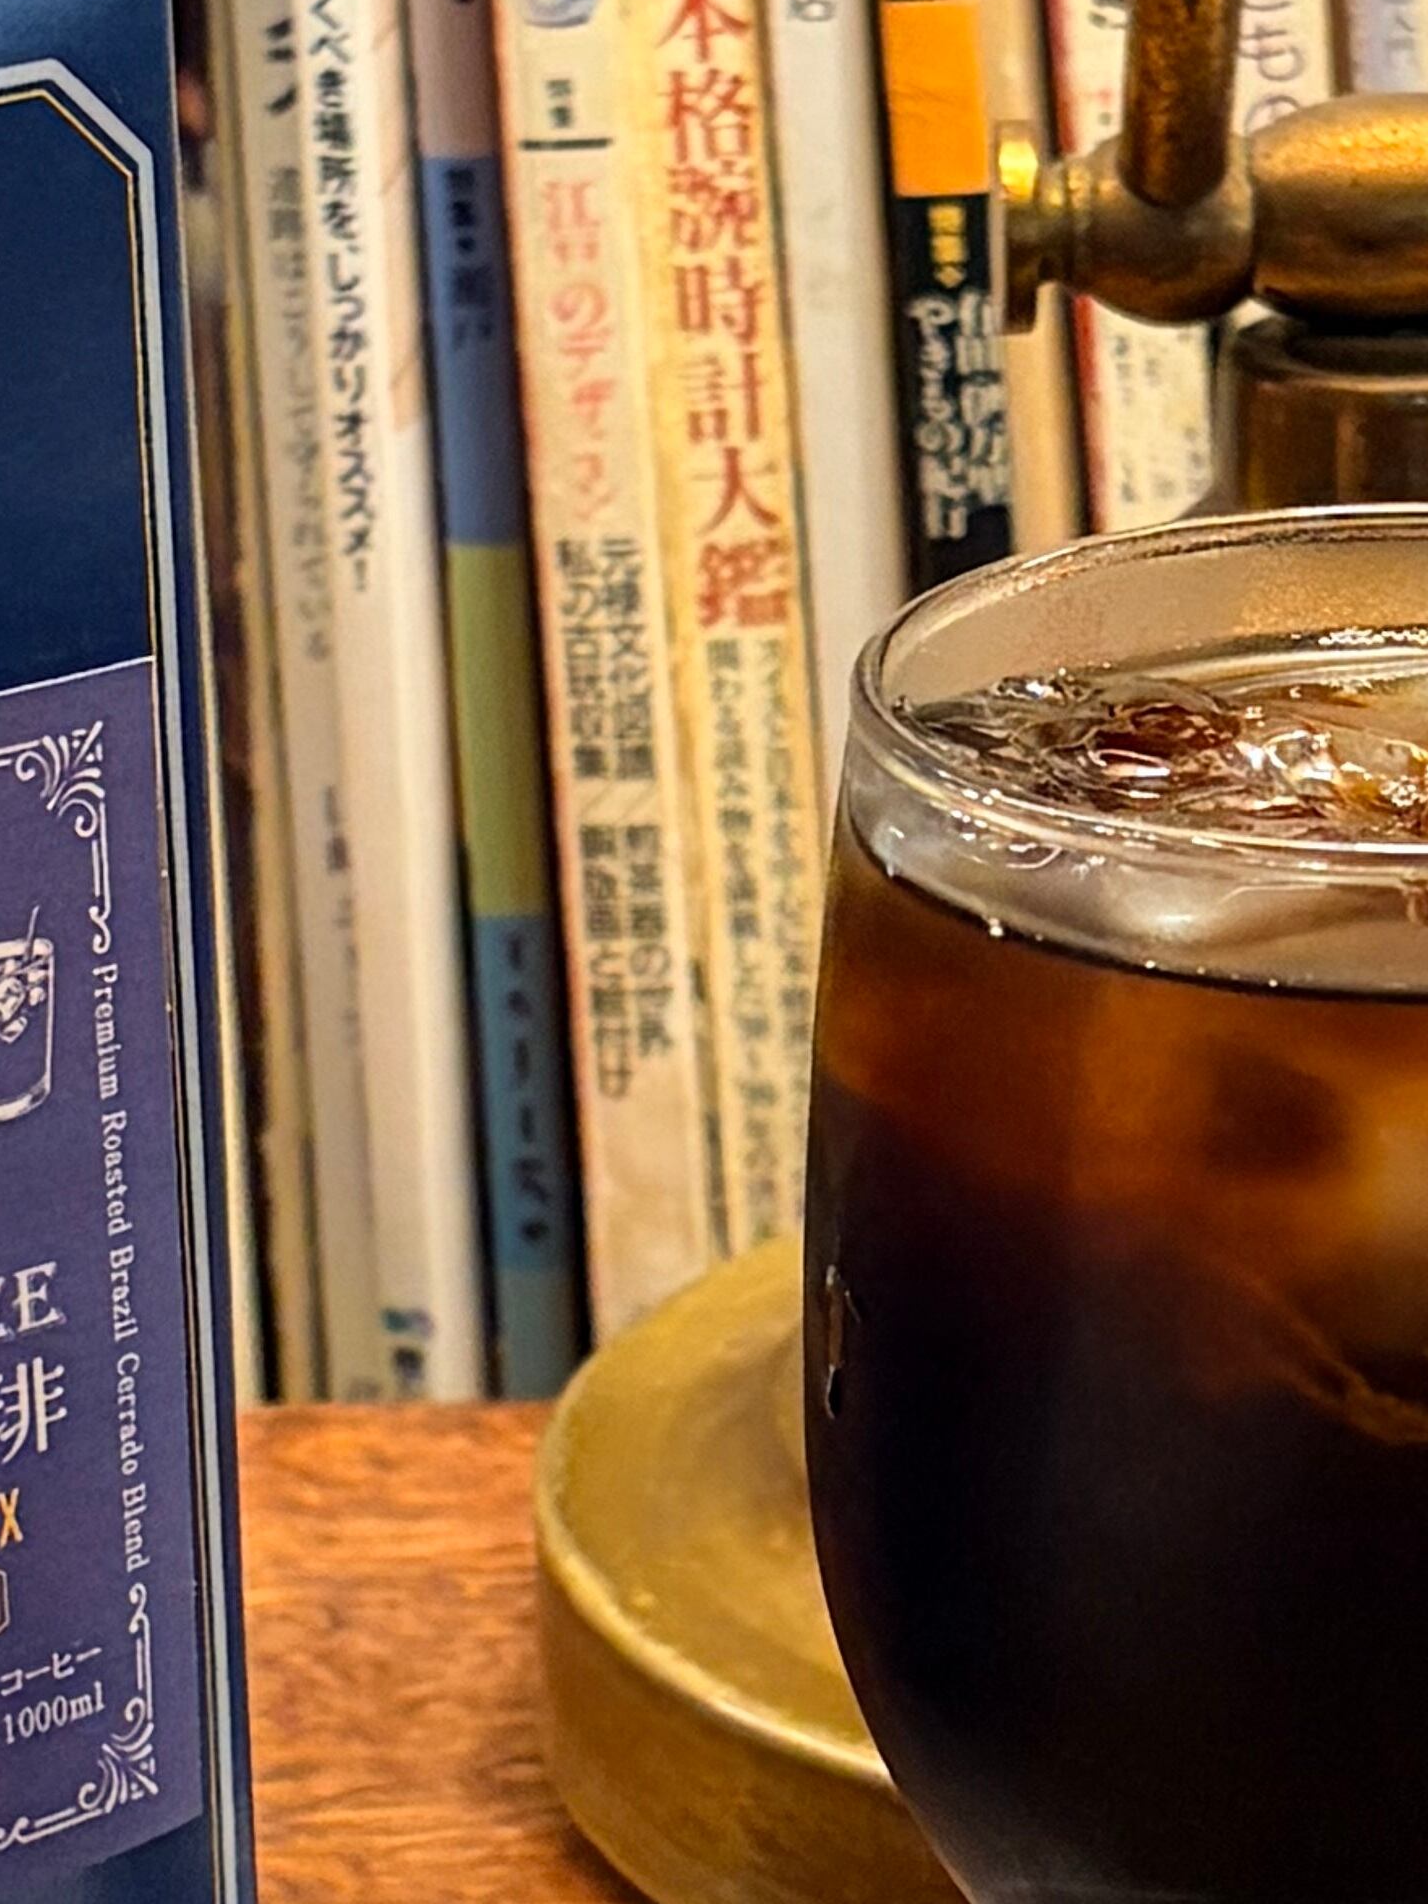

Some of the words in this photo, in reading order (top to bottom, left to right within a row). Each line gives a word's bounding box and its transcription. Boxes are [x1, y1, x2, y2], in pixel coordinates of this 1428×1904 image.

[91, 963, 119, 1101] Premium
[100, 1111, 133, 1238] Roasted
[109, 1247, 140, 1343] Brazil
[116, 1352, 145, 1472] Cerrado
[123, 1481, 149, 1573] Blend
[1, 1681, 106, 1746] 1000ml
